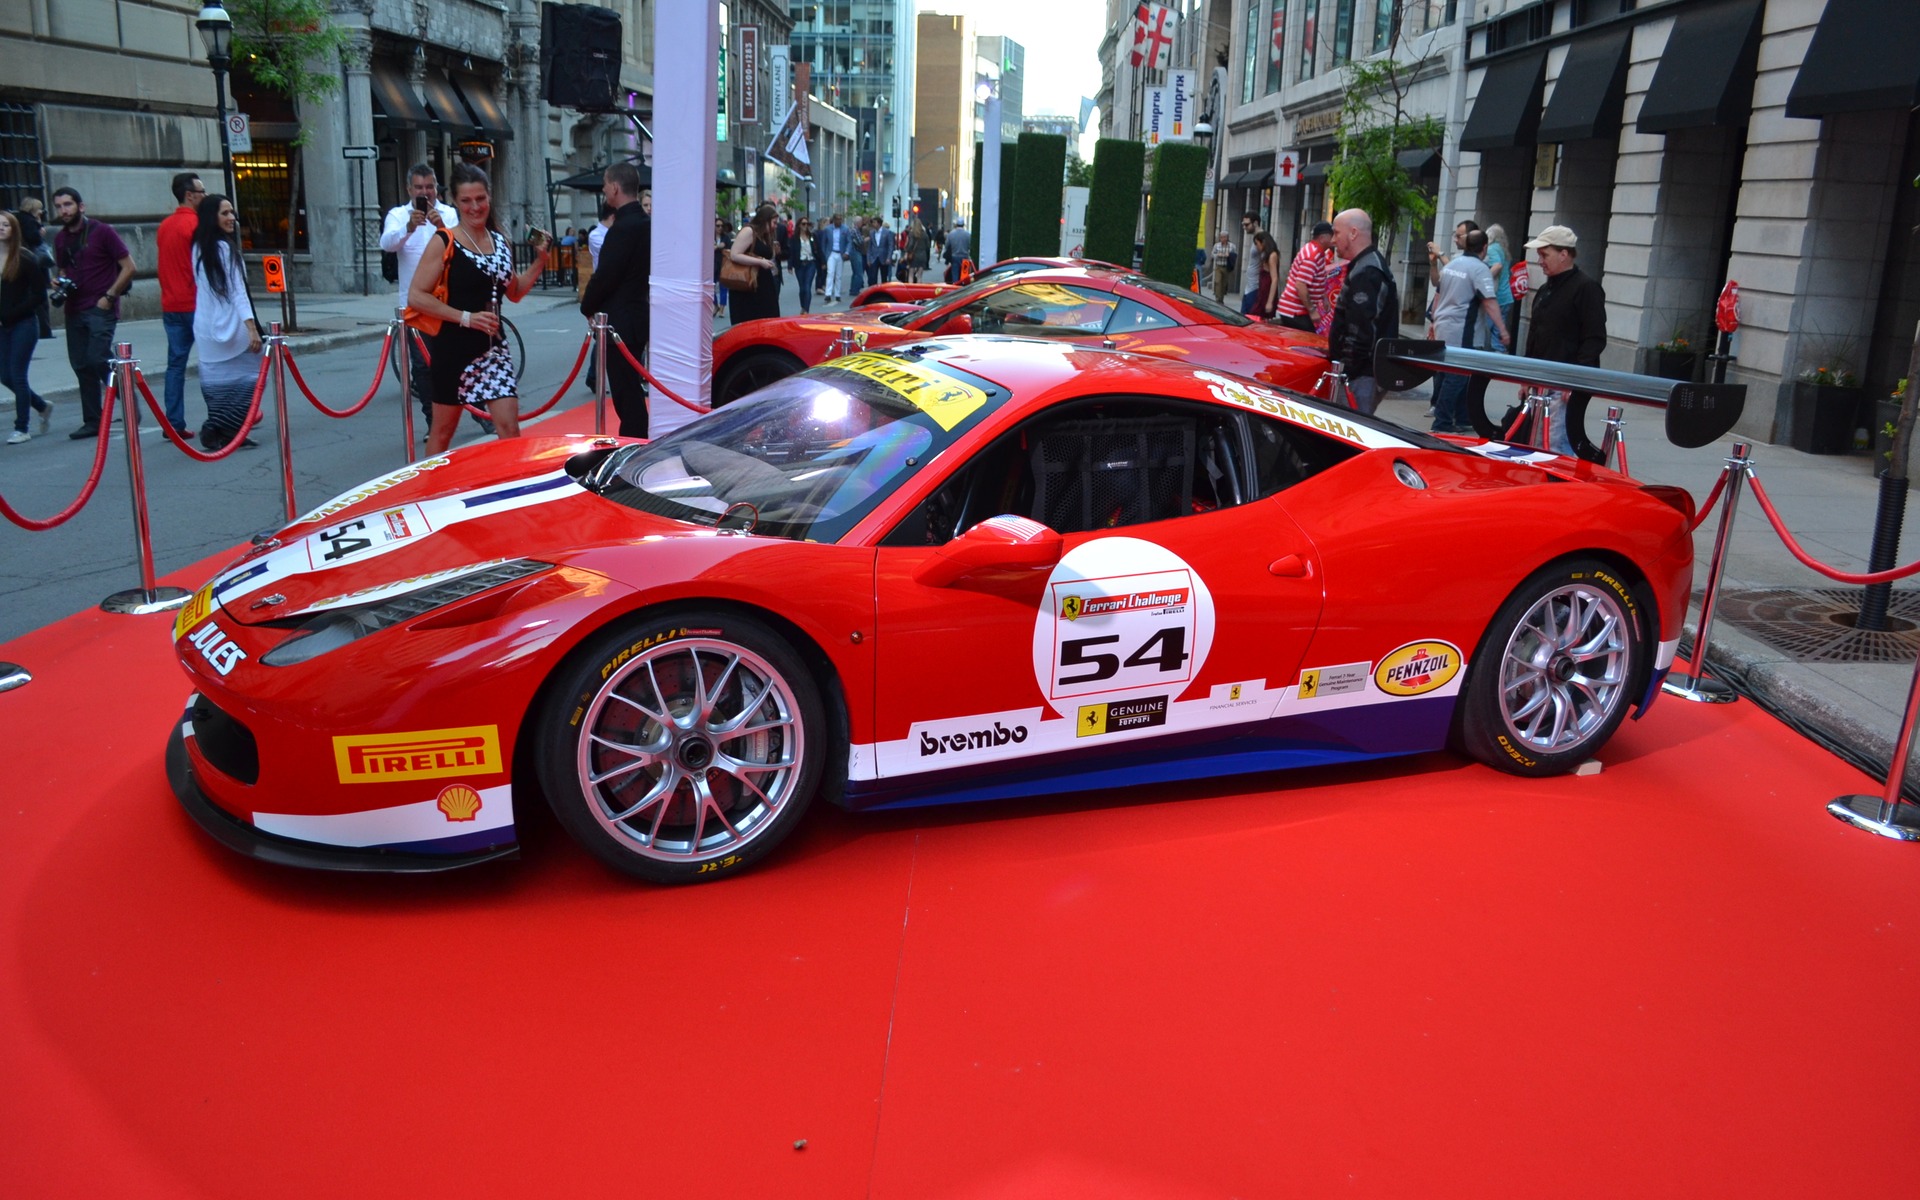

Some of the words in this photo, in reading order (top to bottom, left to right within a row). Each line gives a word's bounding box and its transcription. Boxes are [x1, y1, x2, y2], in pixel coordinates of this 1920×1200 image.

[773, 87, 782, 117] PENNY
[1151, 91, 1164, 133] uniprix
[1174, 74, 1188, 122] uniprix
[1259, 396, 1364, 443] SINGHA
[300, 470, 417, 522] SINGHA
[319, 519, 372, 561] 54
[1083, 599, 1127, 613] Ferrari
[1128, 593, 1182, 608] Challenge
[1594, 571, 1634, 608] PIRELLI
[188, 621, 249, 676] JULES
[601, 629, 676, 679] PIRELLI
[1058, 626, 1189, 686] 54
[1386, 654, 1449, 683] PENNZOIL
[1110, 701, 1164, 717] GENUINE
[1118, 716, 1150, 726] Ferrari
[1235, 699, 1258, 707] SERVICES
[347, 736, 486, 774] PIRELLI
[920, 721, 1028, 756] brembo
